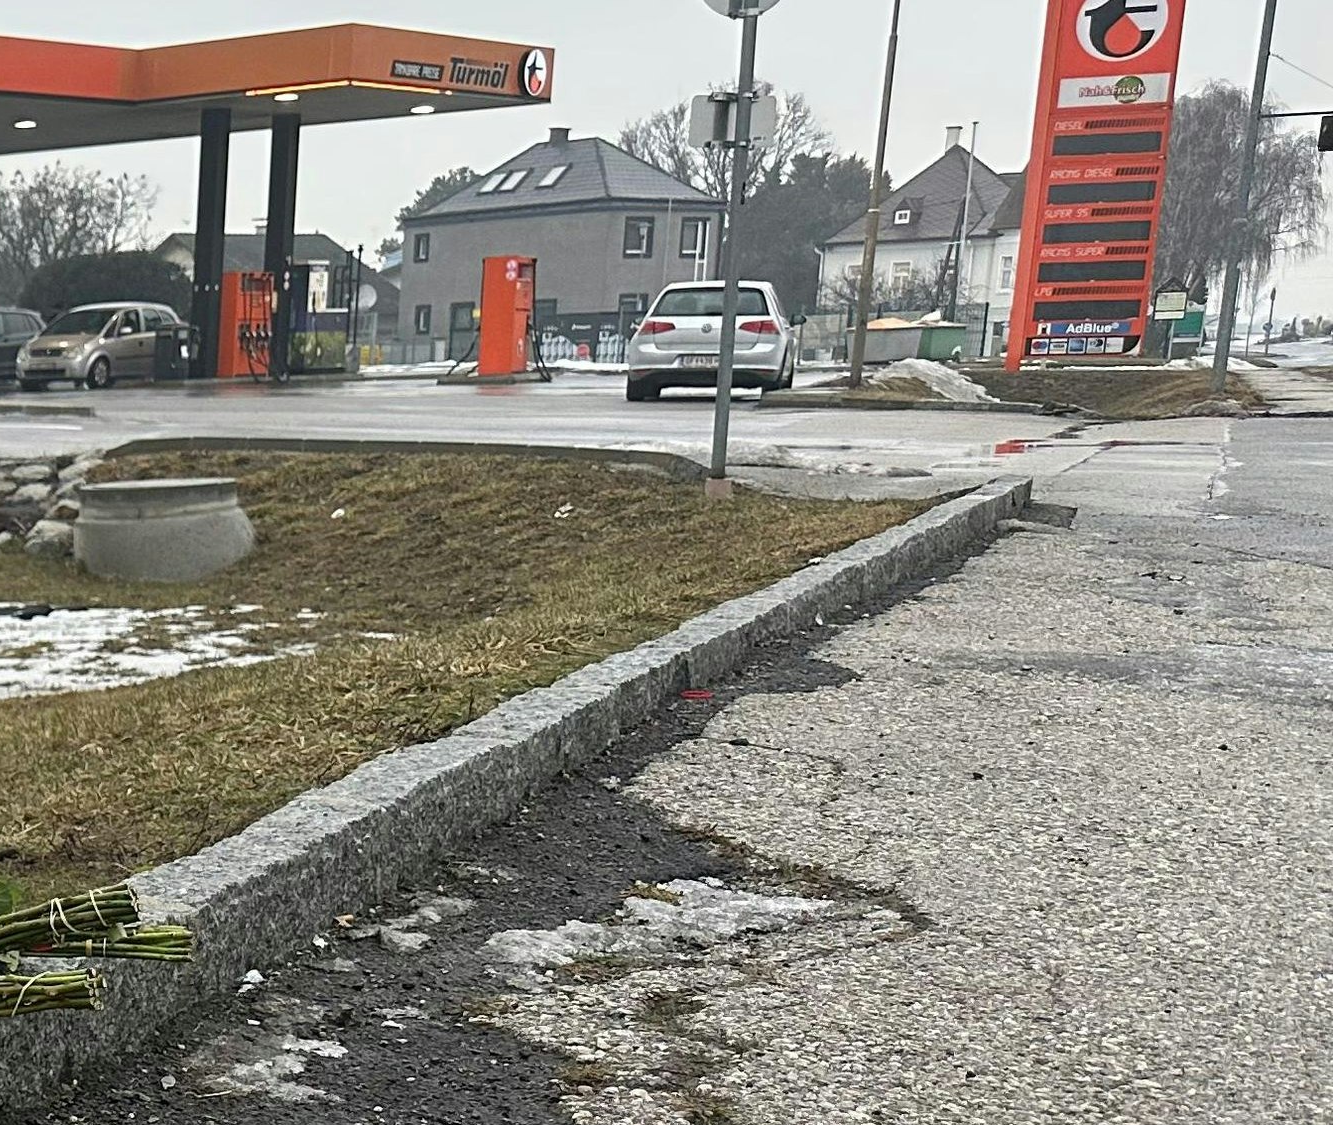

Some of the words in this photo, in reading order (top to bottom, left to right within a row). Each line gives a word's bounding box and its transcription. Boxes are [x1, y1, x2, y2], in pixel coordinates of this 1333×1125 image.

[449, 56, 509, 89] Turmöl
[1079, 83, 1145, 98] Nah&Frisch
[1054, 120, 1085, 131] DIESEL
[1084, 167, 1113, 178] DIESEL
[1034, 286, 1053, 297] LPG
